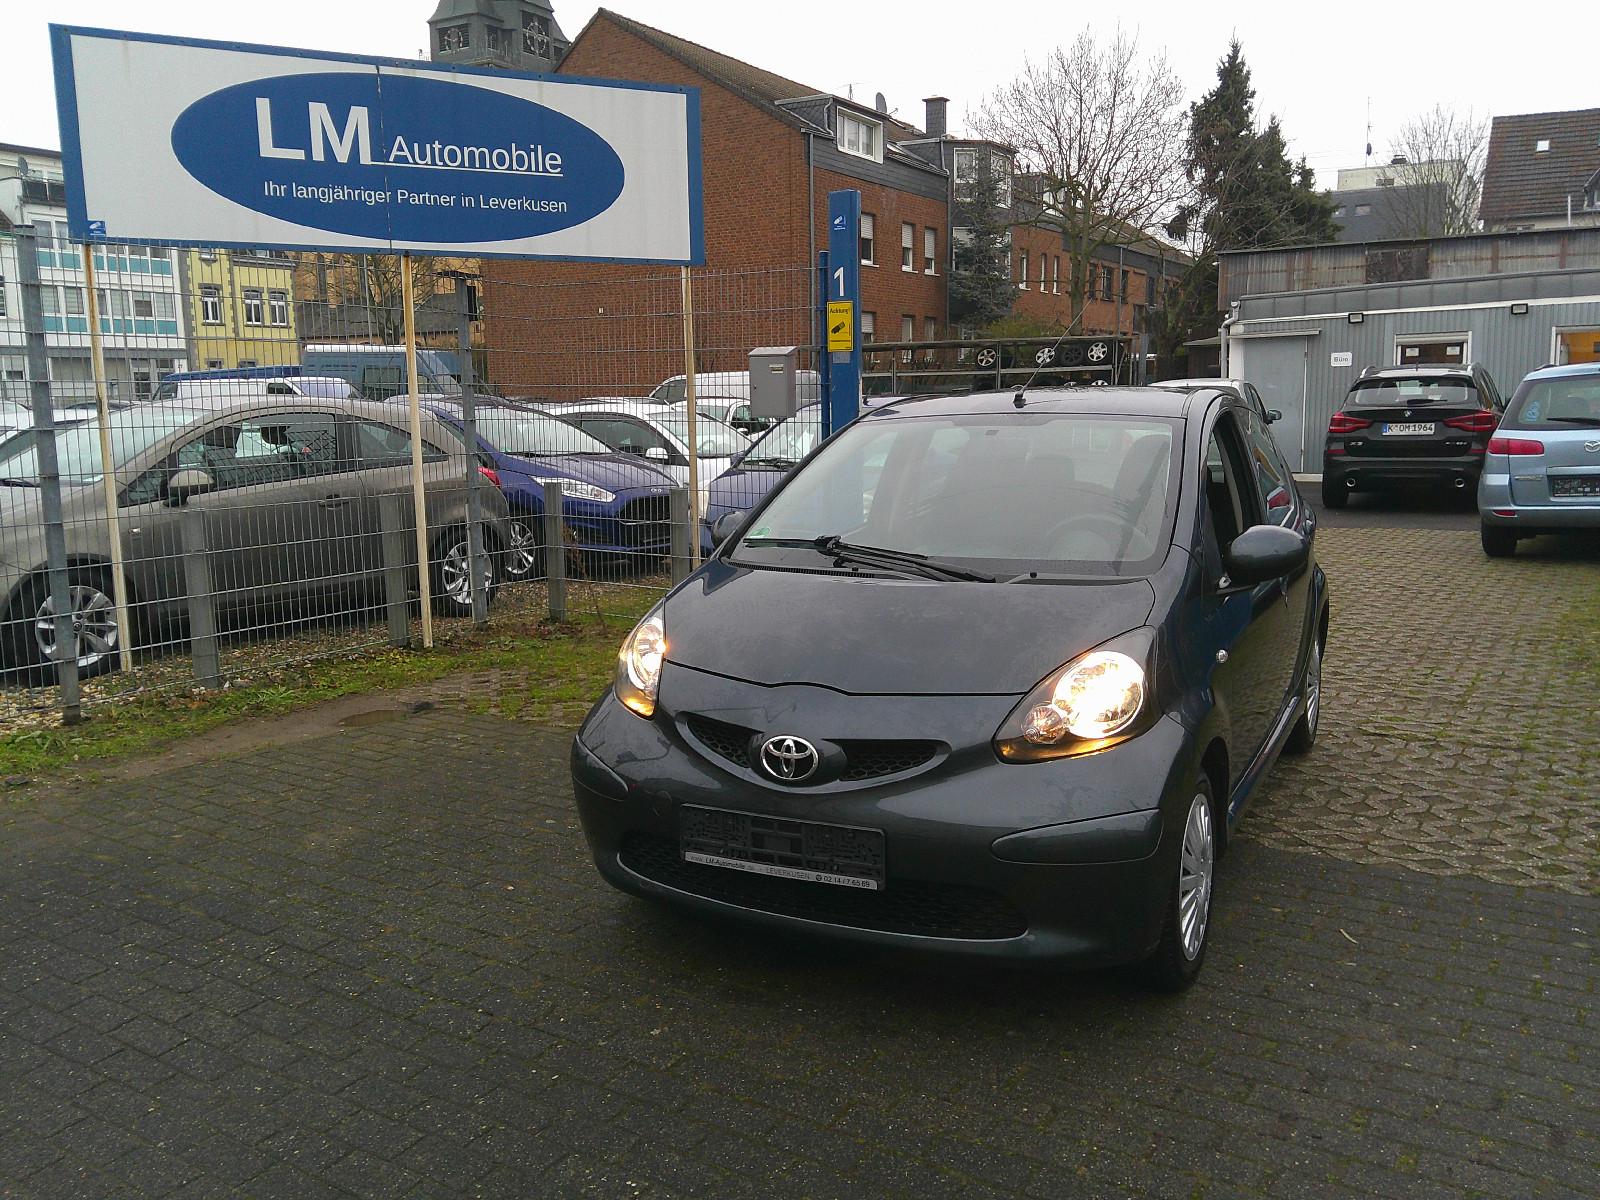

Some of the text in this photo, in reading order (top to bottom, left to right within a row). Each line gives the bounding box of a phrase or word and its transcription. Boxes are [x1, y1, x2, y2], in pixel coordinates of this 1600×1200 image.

[256, 97, 562, 173] LM Automobile
[264, 180, 567, 213] Ihr langjähriger Partner in Leverkusen
[833, 266, 845, 297] 1
